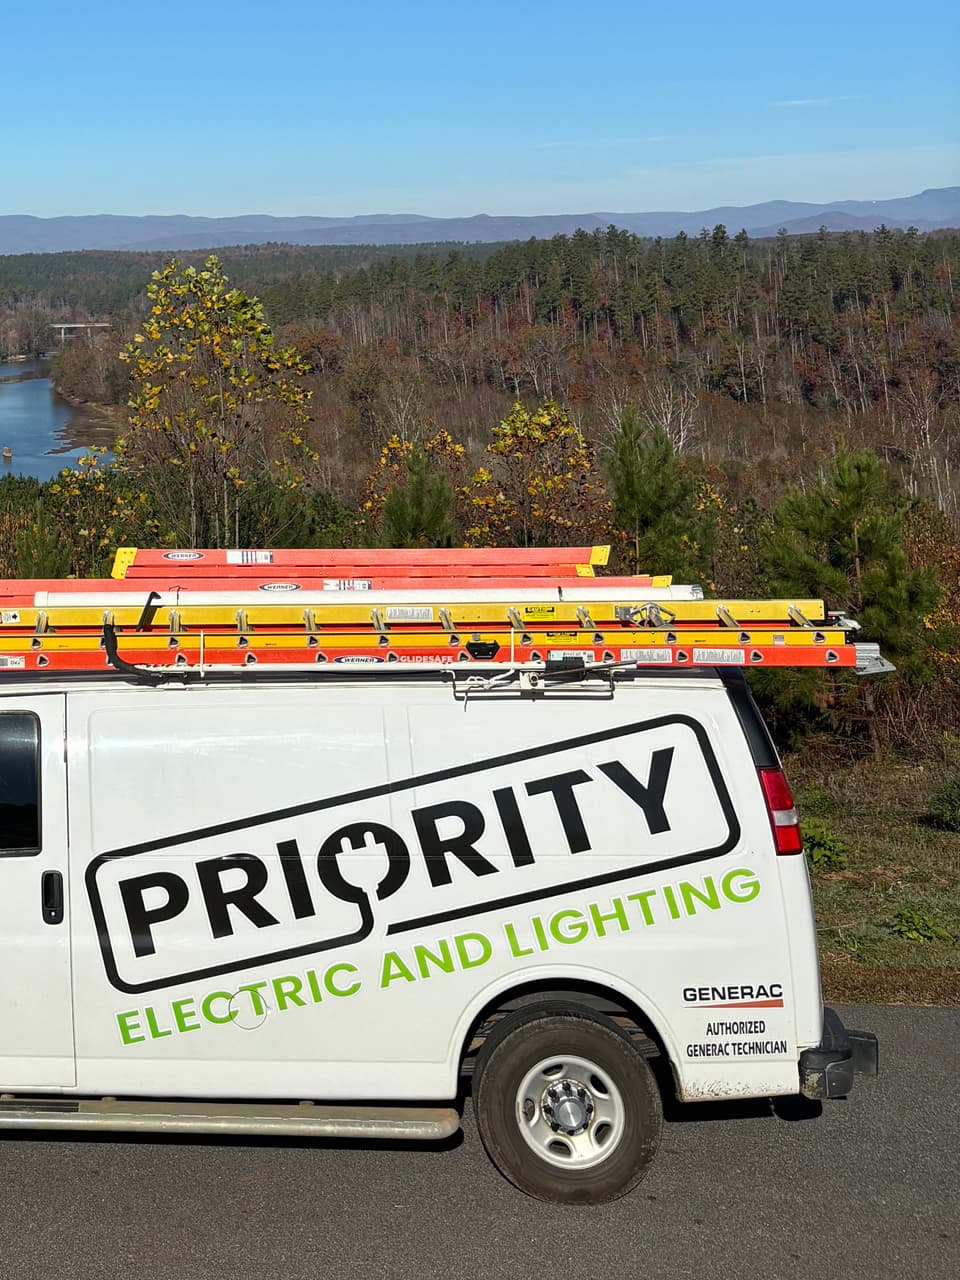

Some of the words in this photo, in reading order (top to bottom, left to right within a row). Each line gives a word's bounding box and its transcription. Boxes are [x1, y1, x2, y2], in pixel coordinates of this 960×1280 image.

[399, 655, 454, 663] GLIDESAFE
[118, 746, 675, 958] PRIORITY
[116, 963, 362, 1045] ELECTRIC
[380, 932, 492, 988] AND
[504, 868, 761, 958] LIGHTING
[683, 984, 783, 1001] GENERAC
[706, 1020, 766, 1036] AUTHORIZED
[686, 1042, 730, 1057] GENERAC
[732, 1040, 787, 1056] TECHNICIAN
